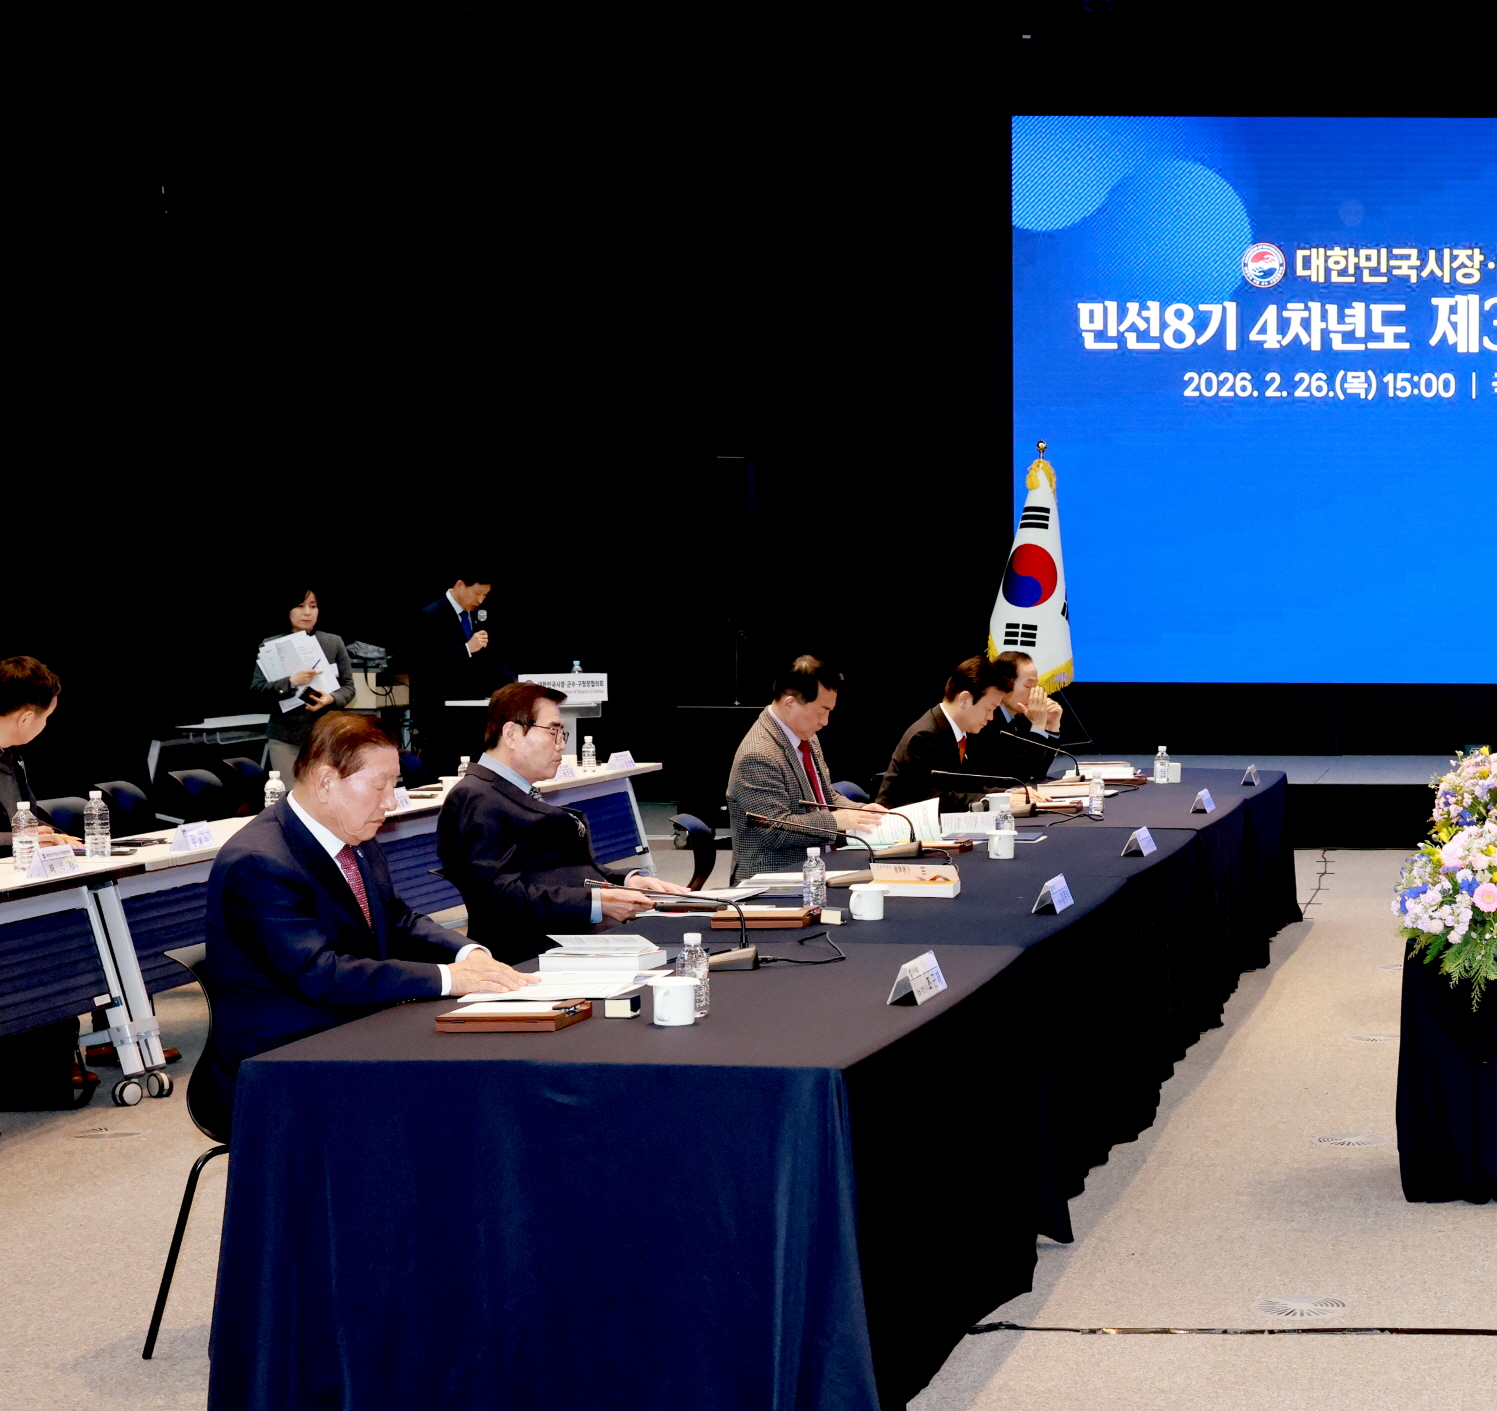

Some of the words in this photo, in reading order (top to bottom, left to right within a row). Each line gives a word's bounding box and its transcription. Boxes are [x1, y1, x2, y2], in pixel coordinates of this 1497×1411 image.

[1078, 301, 1236, 351] 민선8기
[1249, 302, 1410, 352] 4차년도
[1184, 371, 1259, 398] 2026.
[1265, 371, 1288, 398] 2.
[1294, 369, 1377, 401] 26.(목)
[1383, 372, 1456, 399] 15:00
